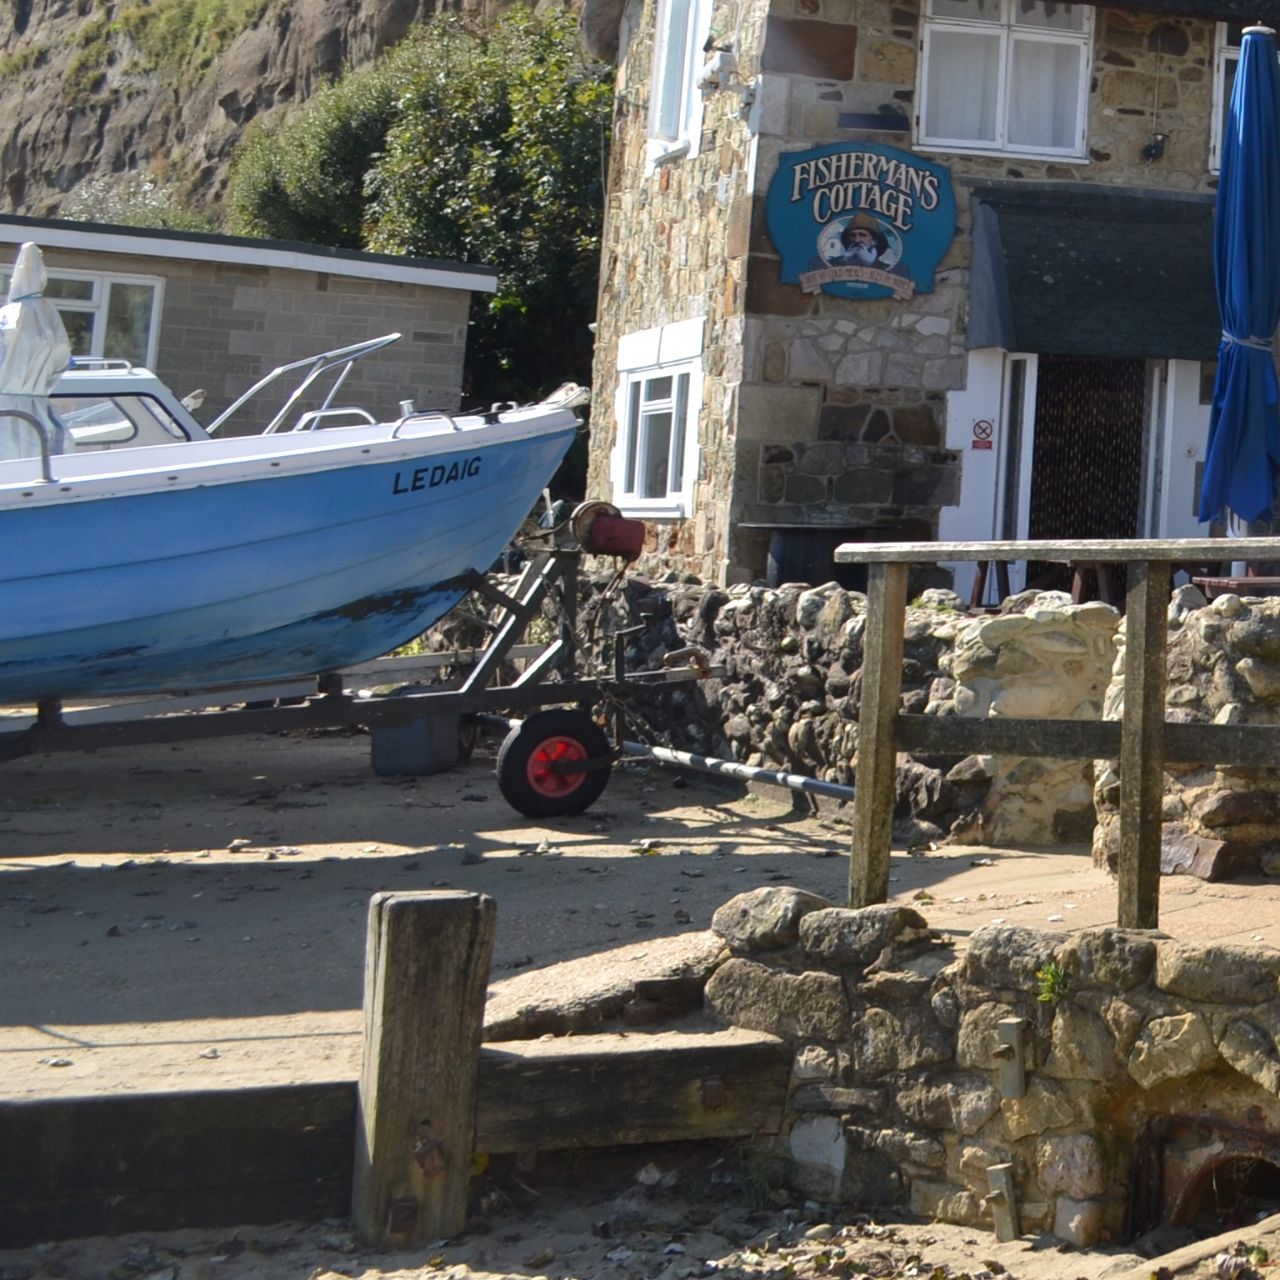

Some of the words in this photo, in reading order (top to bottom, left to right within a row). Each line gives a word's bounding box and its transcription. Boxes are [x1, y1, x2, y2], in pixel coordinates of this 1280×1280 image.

[790, 152, 939, 210] FISHERMAN'S
[812, 181, 913, 230] COTTAGE
[392, 455, 482, 495] LEDAIG
